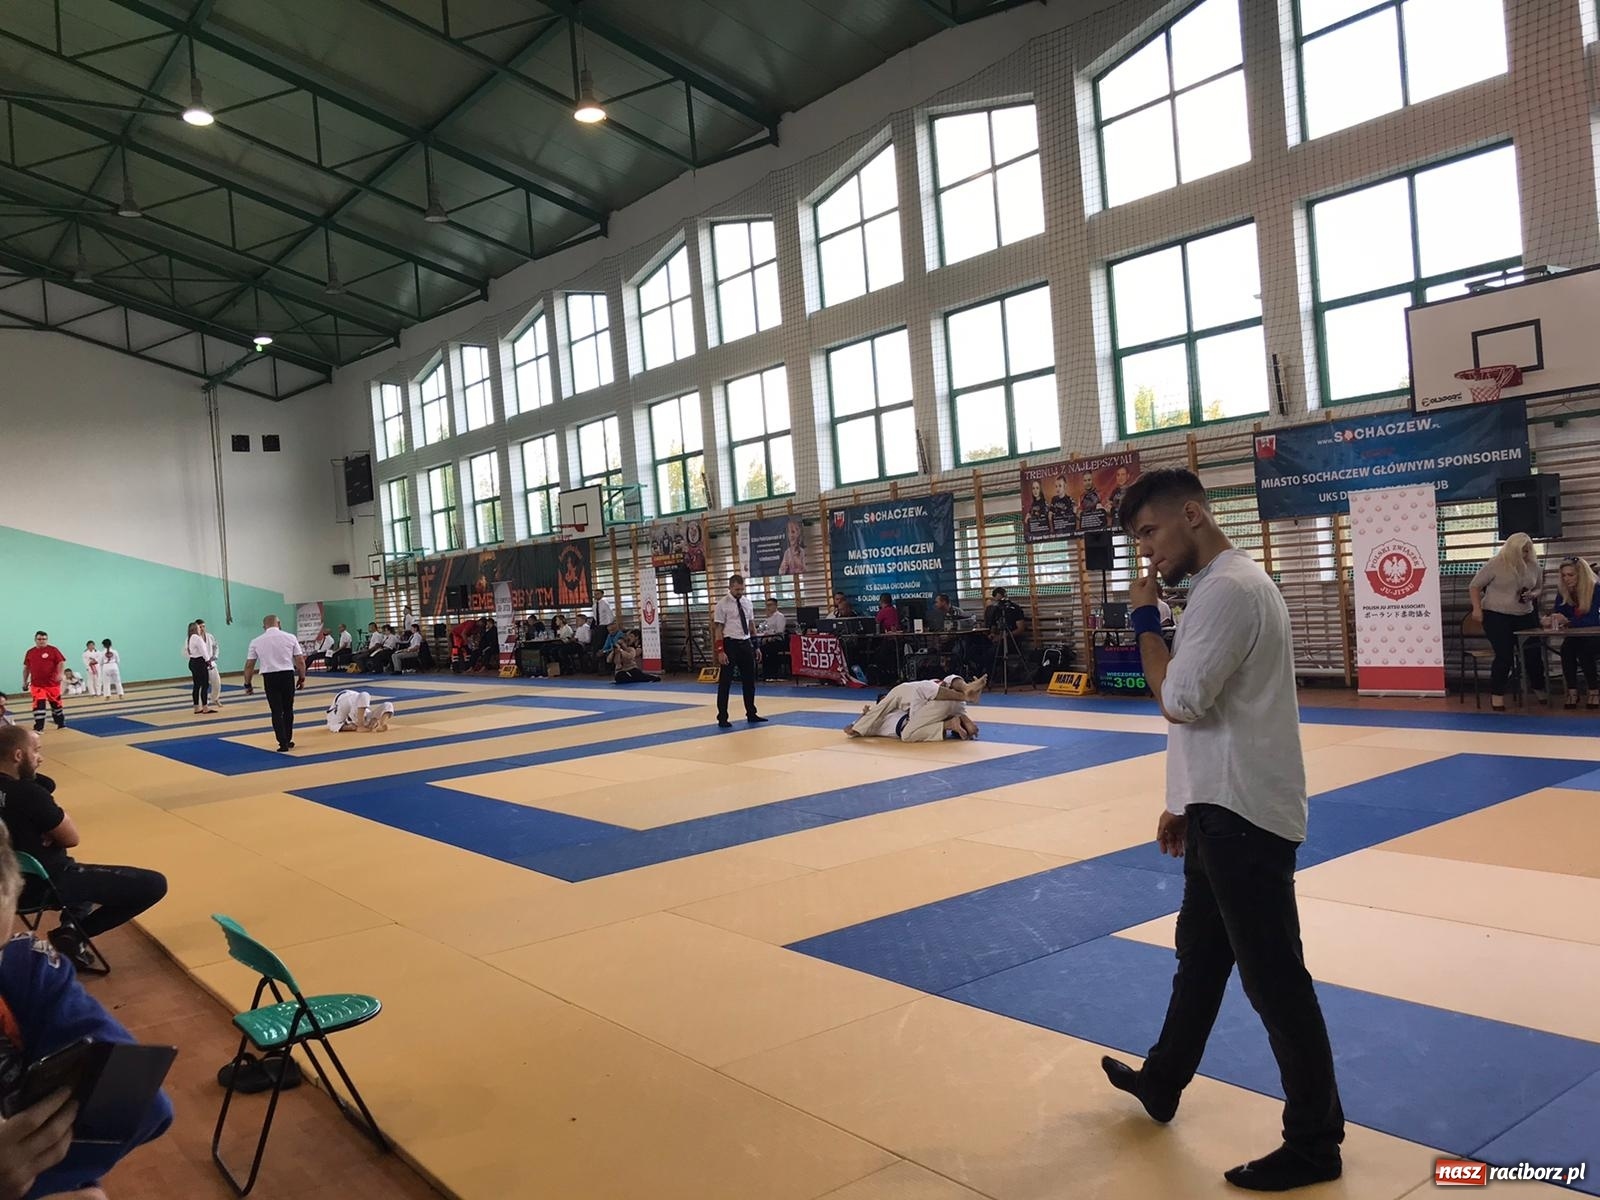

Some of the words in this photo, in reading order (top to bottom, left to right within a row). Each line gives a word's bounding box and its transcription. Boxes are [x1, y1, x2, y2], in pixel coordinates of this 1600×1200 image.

[1024, 467, 1058, 480] TRENUJ
[1060, 465, 1067, 475] Z
[1067, 454, 1133, 473] NAJLEPSZYMI
[1261, 474, 1301, 489] MIASTO
[1302, 466, 1370, 485] SOCHACZEW
[1372, 457, 1435, 477] GŁÓWNYM
[1437, 447, 1522, 468] SPONSOREM
[1319, 491, 1338, 503] UKS
[848, 547, 880, 561] MIASTO
[880, 542, 935, 558] SOCHACZEW
[1370, 544, 1391, 568] POLSKI
[1392, 544, 1420, 567] ZWIĄZEK
[843, 562, 886, 576] GŁÓWNYM
[887, 558, 942, 573] SPONSOREM
[1380, 583, 1415, 596] JU-JITSU
[1055, 673, 1074, 685] MATA
[1072, 674, 1082, 690] 4
[1114, 677, 1146, 689] 3:06
